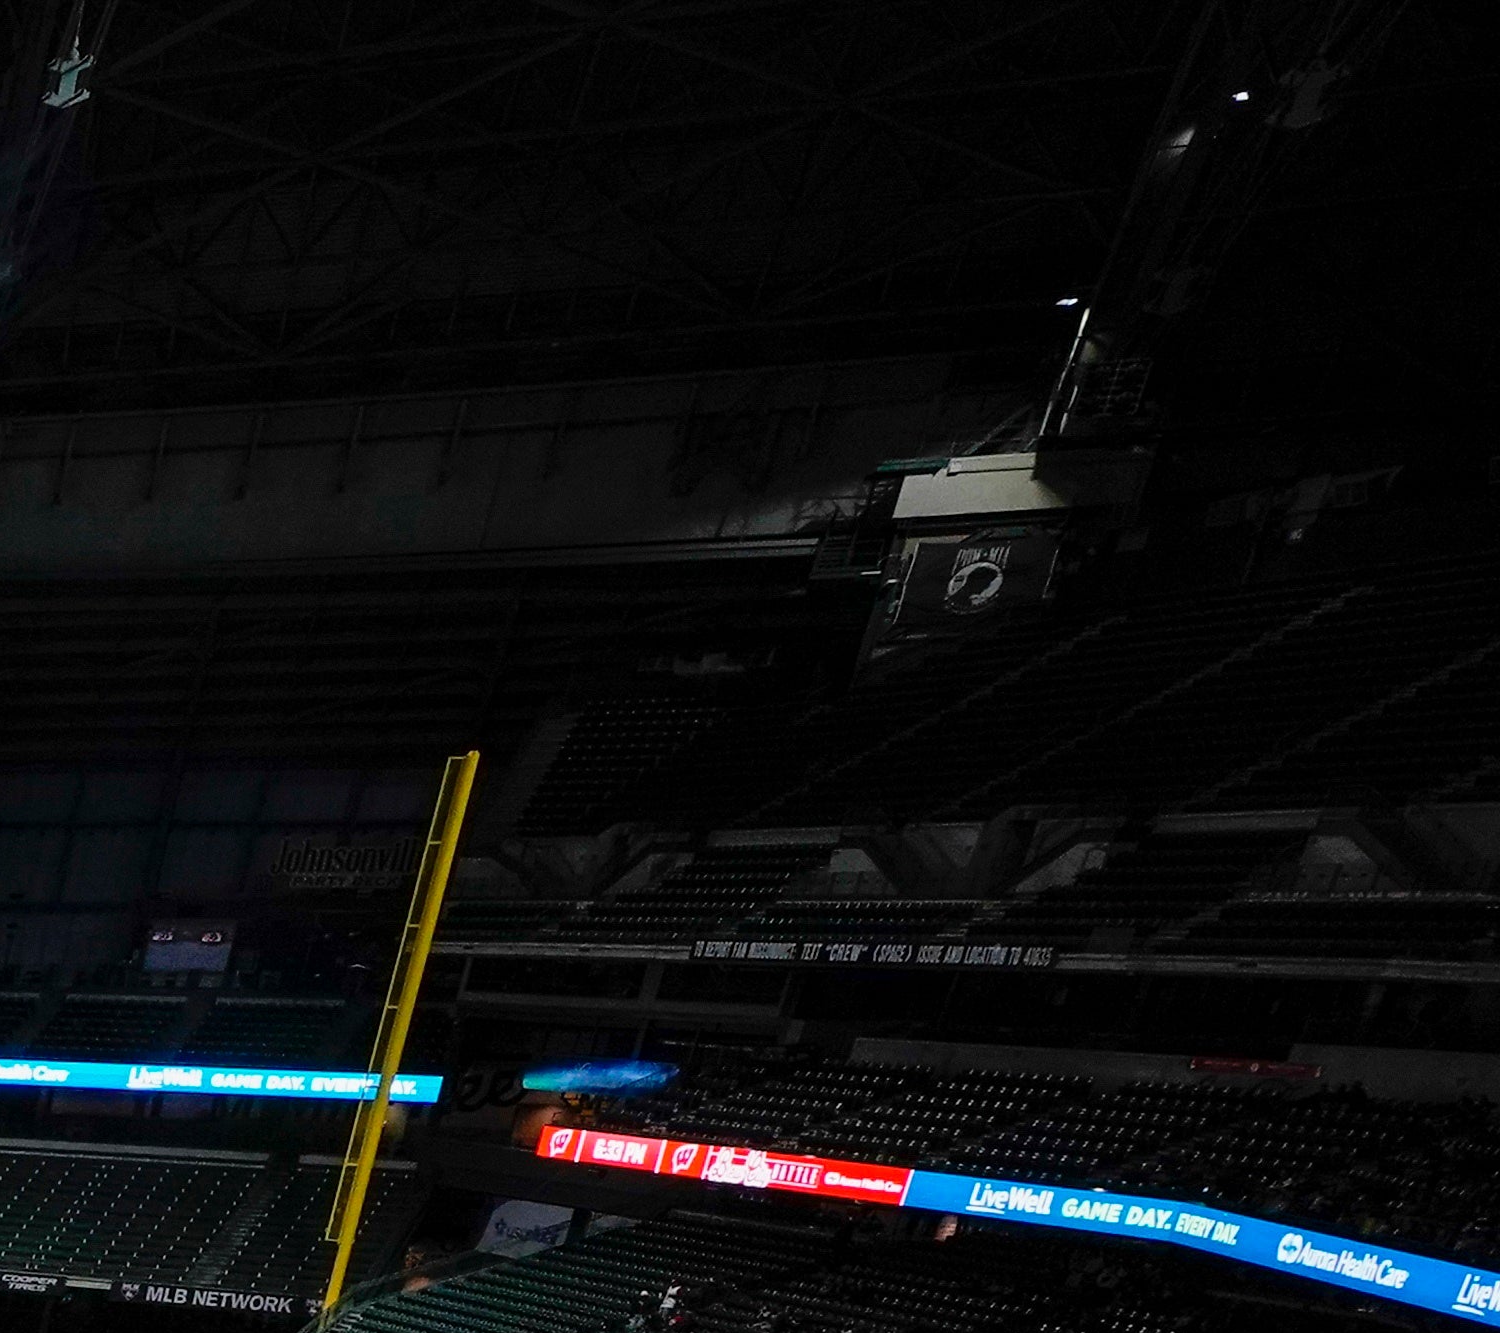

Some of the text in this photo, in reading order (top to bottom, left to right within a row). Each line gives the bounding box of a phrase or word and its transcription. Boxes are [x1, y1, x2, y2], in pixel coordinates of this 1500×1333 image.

[968, 1182, 1240, 1246] LiveWell GAME DAY. EVERY DAY.
[1298, 1241, 1409, 1289] Aurora Health Care
[1, 1273, 58, 1287] COOPER
[7, 1281, 47, 1293] TIRES
[145, 1285, 188, 1305] MLB
[192, 1288, 293, 1314] NETWORK
